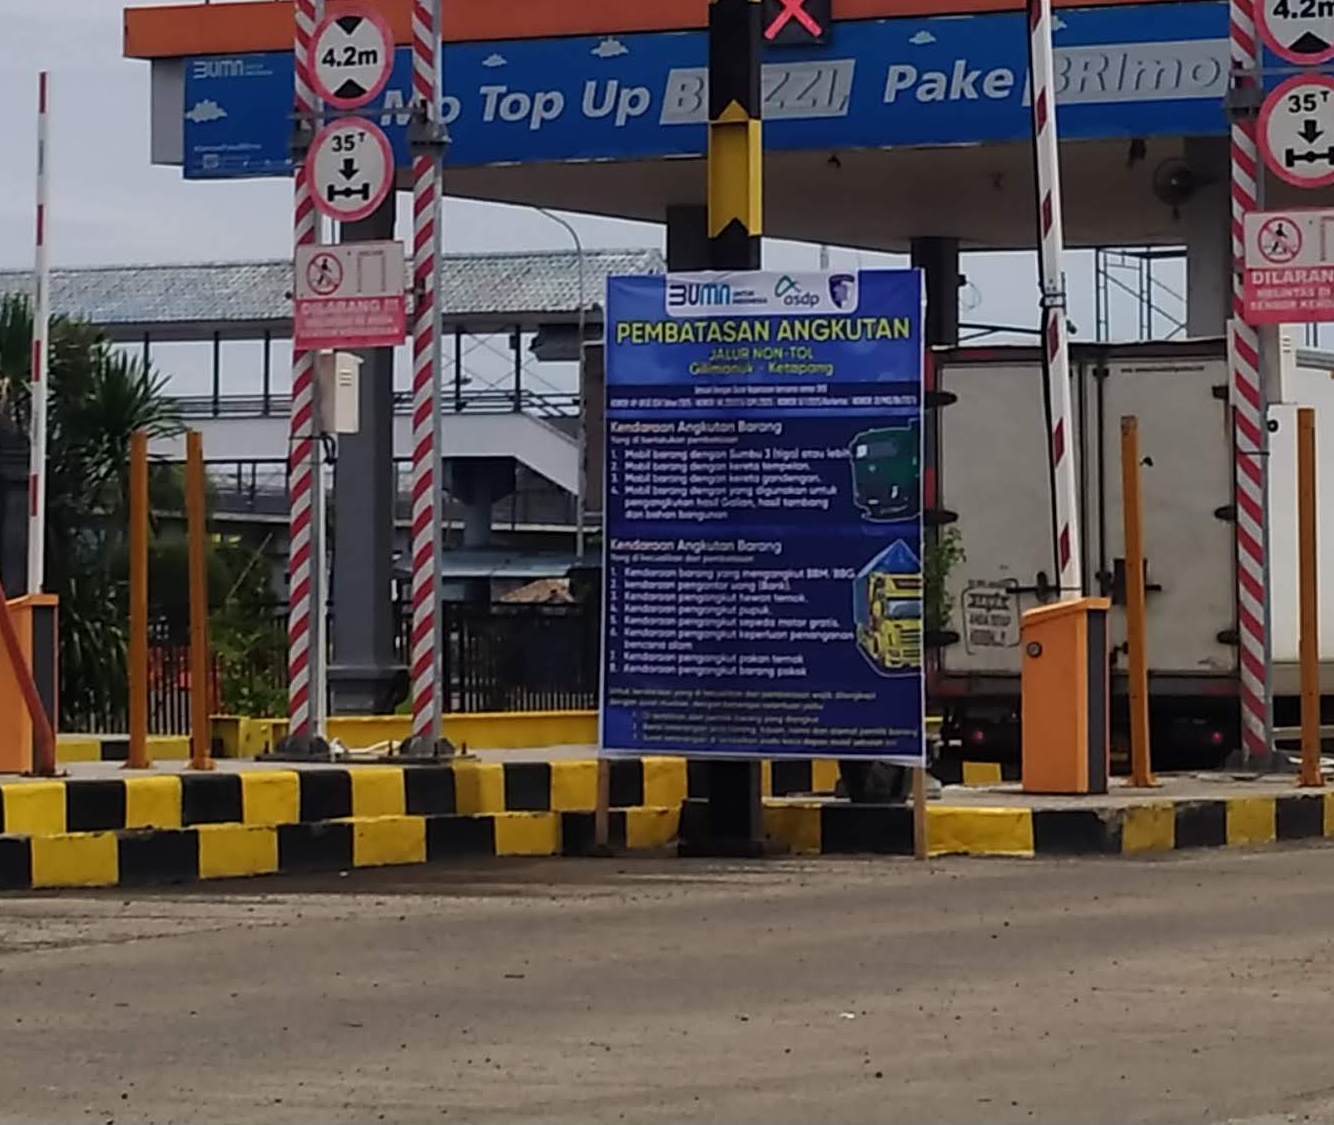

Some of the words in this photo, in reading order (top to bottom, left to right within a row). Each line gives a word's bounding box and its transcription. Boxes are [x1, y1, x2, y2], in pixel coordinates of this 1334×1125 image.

[321, 46, 378, 68] 4.2m
[479, 84, 566, 130] Top
[580, 78, 651, 128] Up
[883, 58, 1014, 103] Pake
[616, 321, 769, 345] PEMBATASAN
[777, 317, 910, 342] ANGKUTAN
[710, 348, 749, 361] JALUR
[753, 346, 813, 360] NON-TOL
[769, 362, 834, 377] Ketapang
[610, 421, 675, 434] Kendaraan
[677, 420, 735, 436] Angkutan
[737, 420, 783, 436] Barang
[653, 450, 687, 462] barang
[653, 461, 687, 474] barang
[653, 473, 687, 486] barang
[653, 485, 687, 497] barang
[610, 539, 675, 551] Kendaraan
[677, 538, 735, 554] Angkutan
[737, 539, 783, 555] Barang
